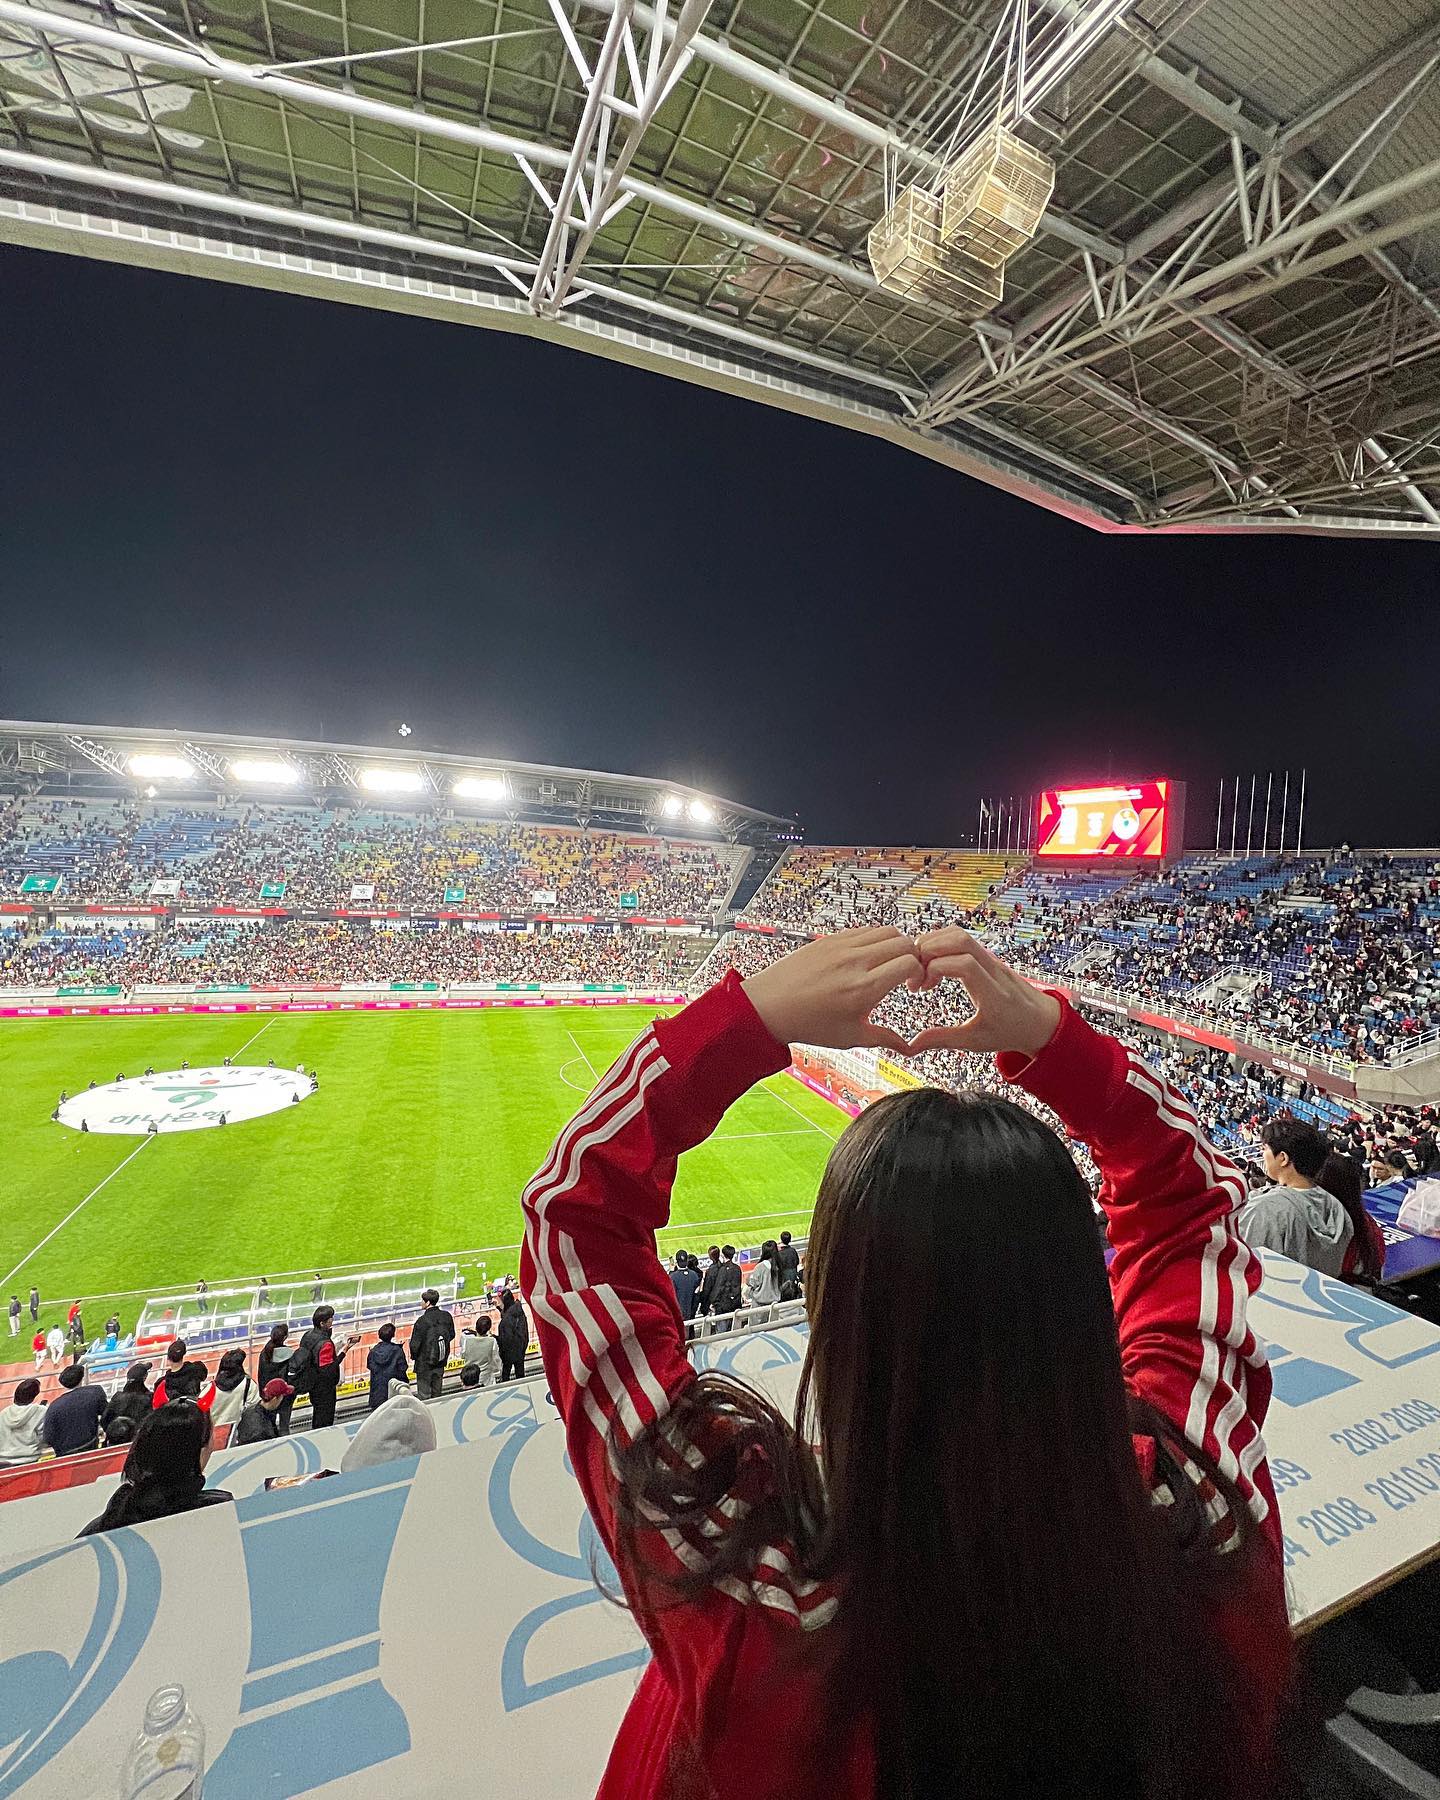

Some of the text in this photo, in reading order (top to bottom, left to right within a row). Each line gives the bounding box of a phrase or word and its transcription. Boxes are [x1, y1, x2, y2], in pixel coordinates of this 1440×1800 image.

[1329, 1419, 1403, 1457] 2002
[1379, 1398, 1440, 1434] 2009
[1296, 1496, 1377, 1547] 2008
[1363, 1466, 1440, 1512] 2010
